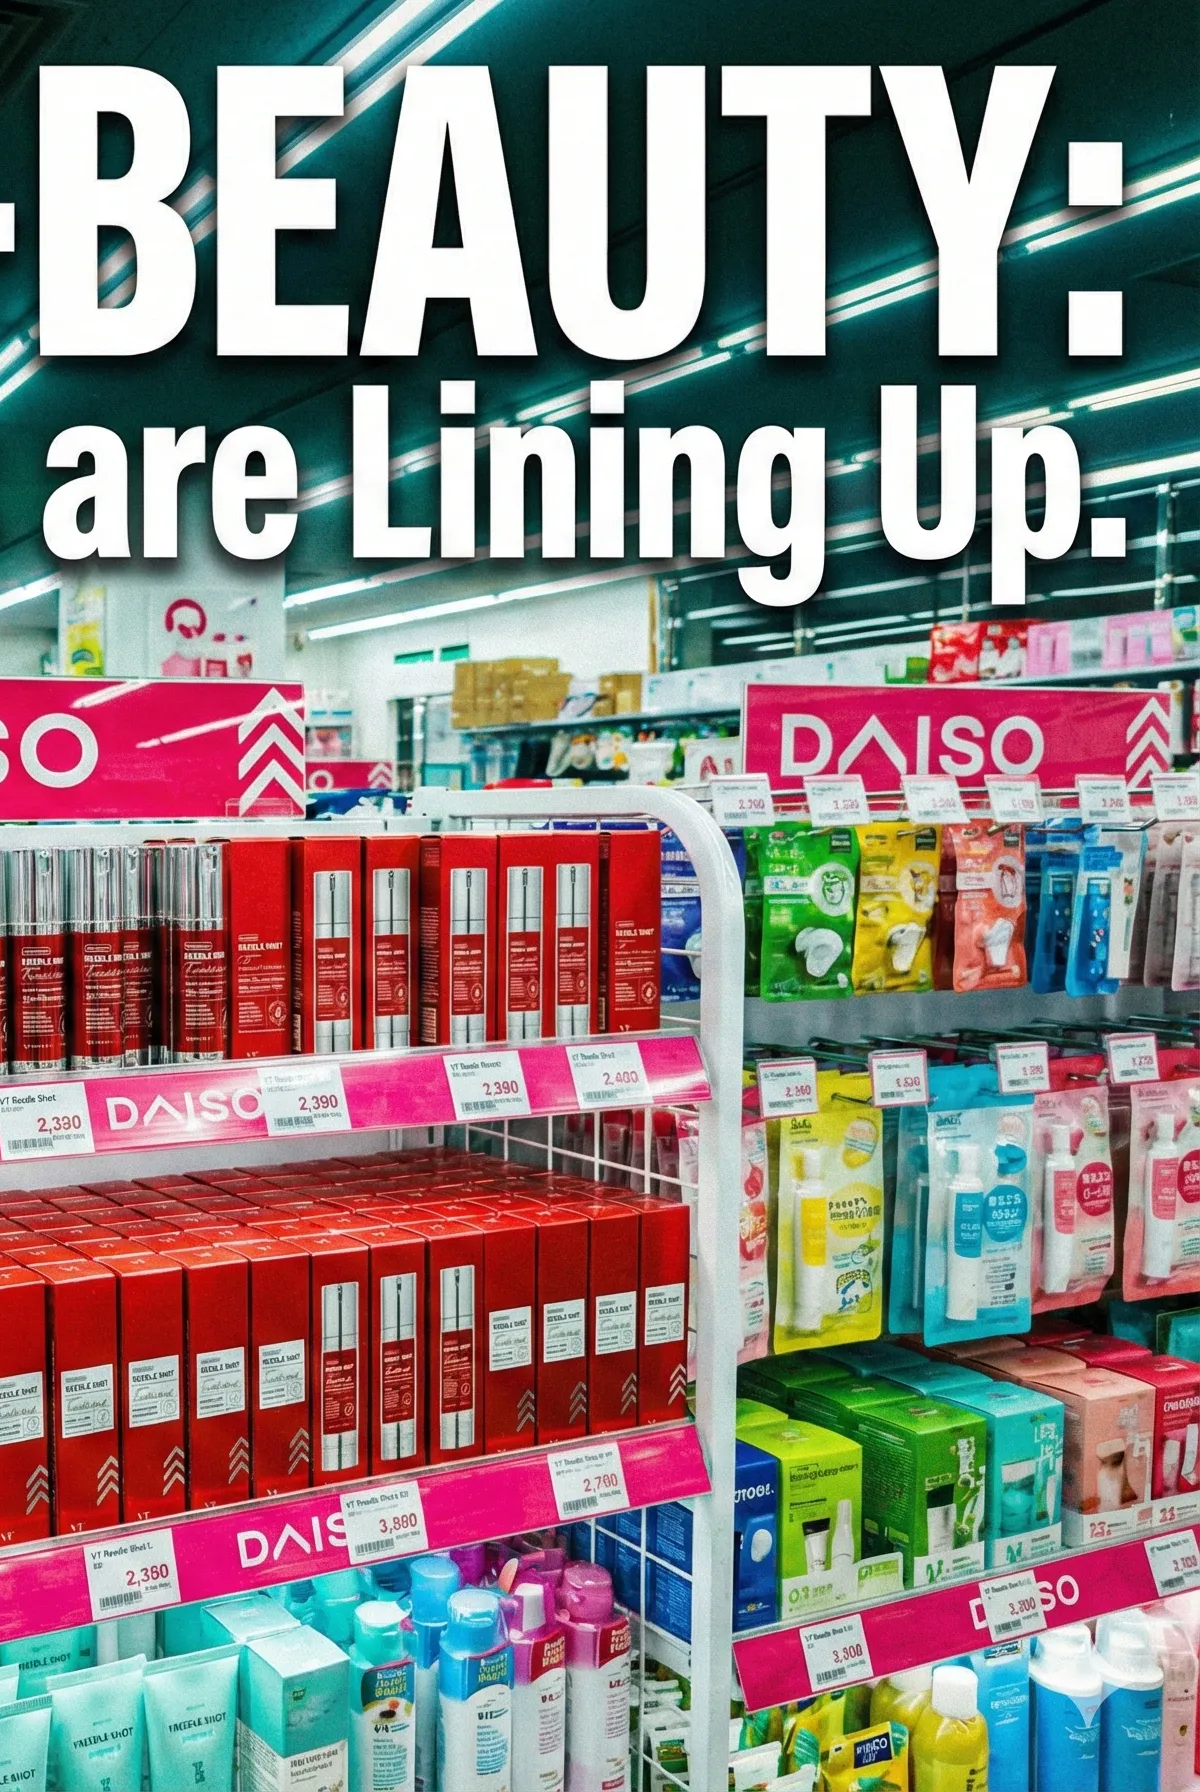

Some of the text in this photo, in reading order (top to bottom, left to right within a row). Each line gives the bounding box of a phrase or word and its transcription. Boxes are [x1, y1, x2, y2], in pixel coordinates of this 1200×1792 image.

[780, 713, 1045, 778] DAISO
[298, 1094, 338, 1114] 2,390
[237, 1512, 348, 1568] DAIS
